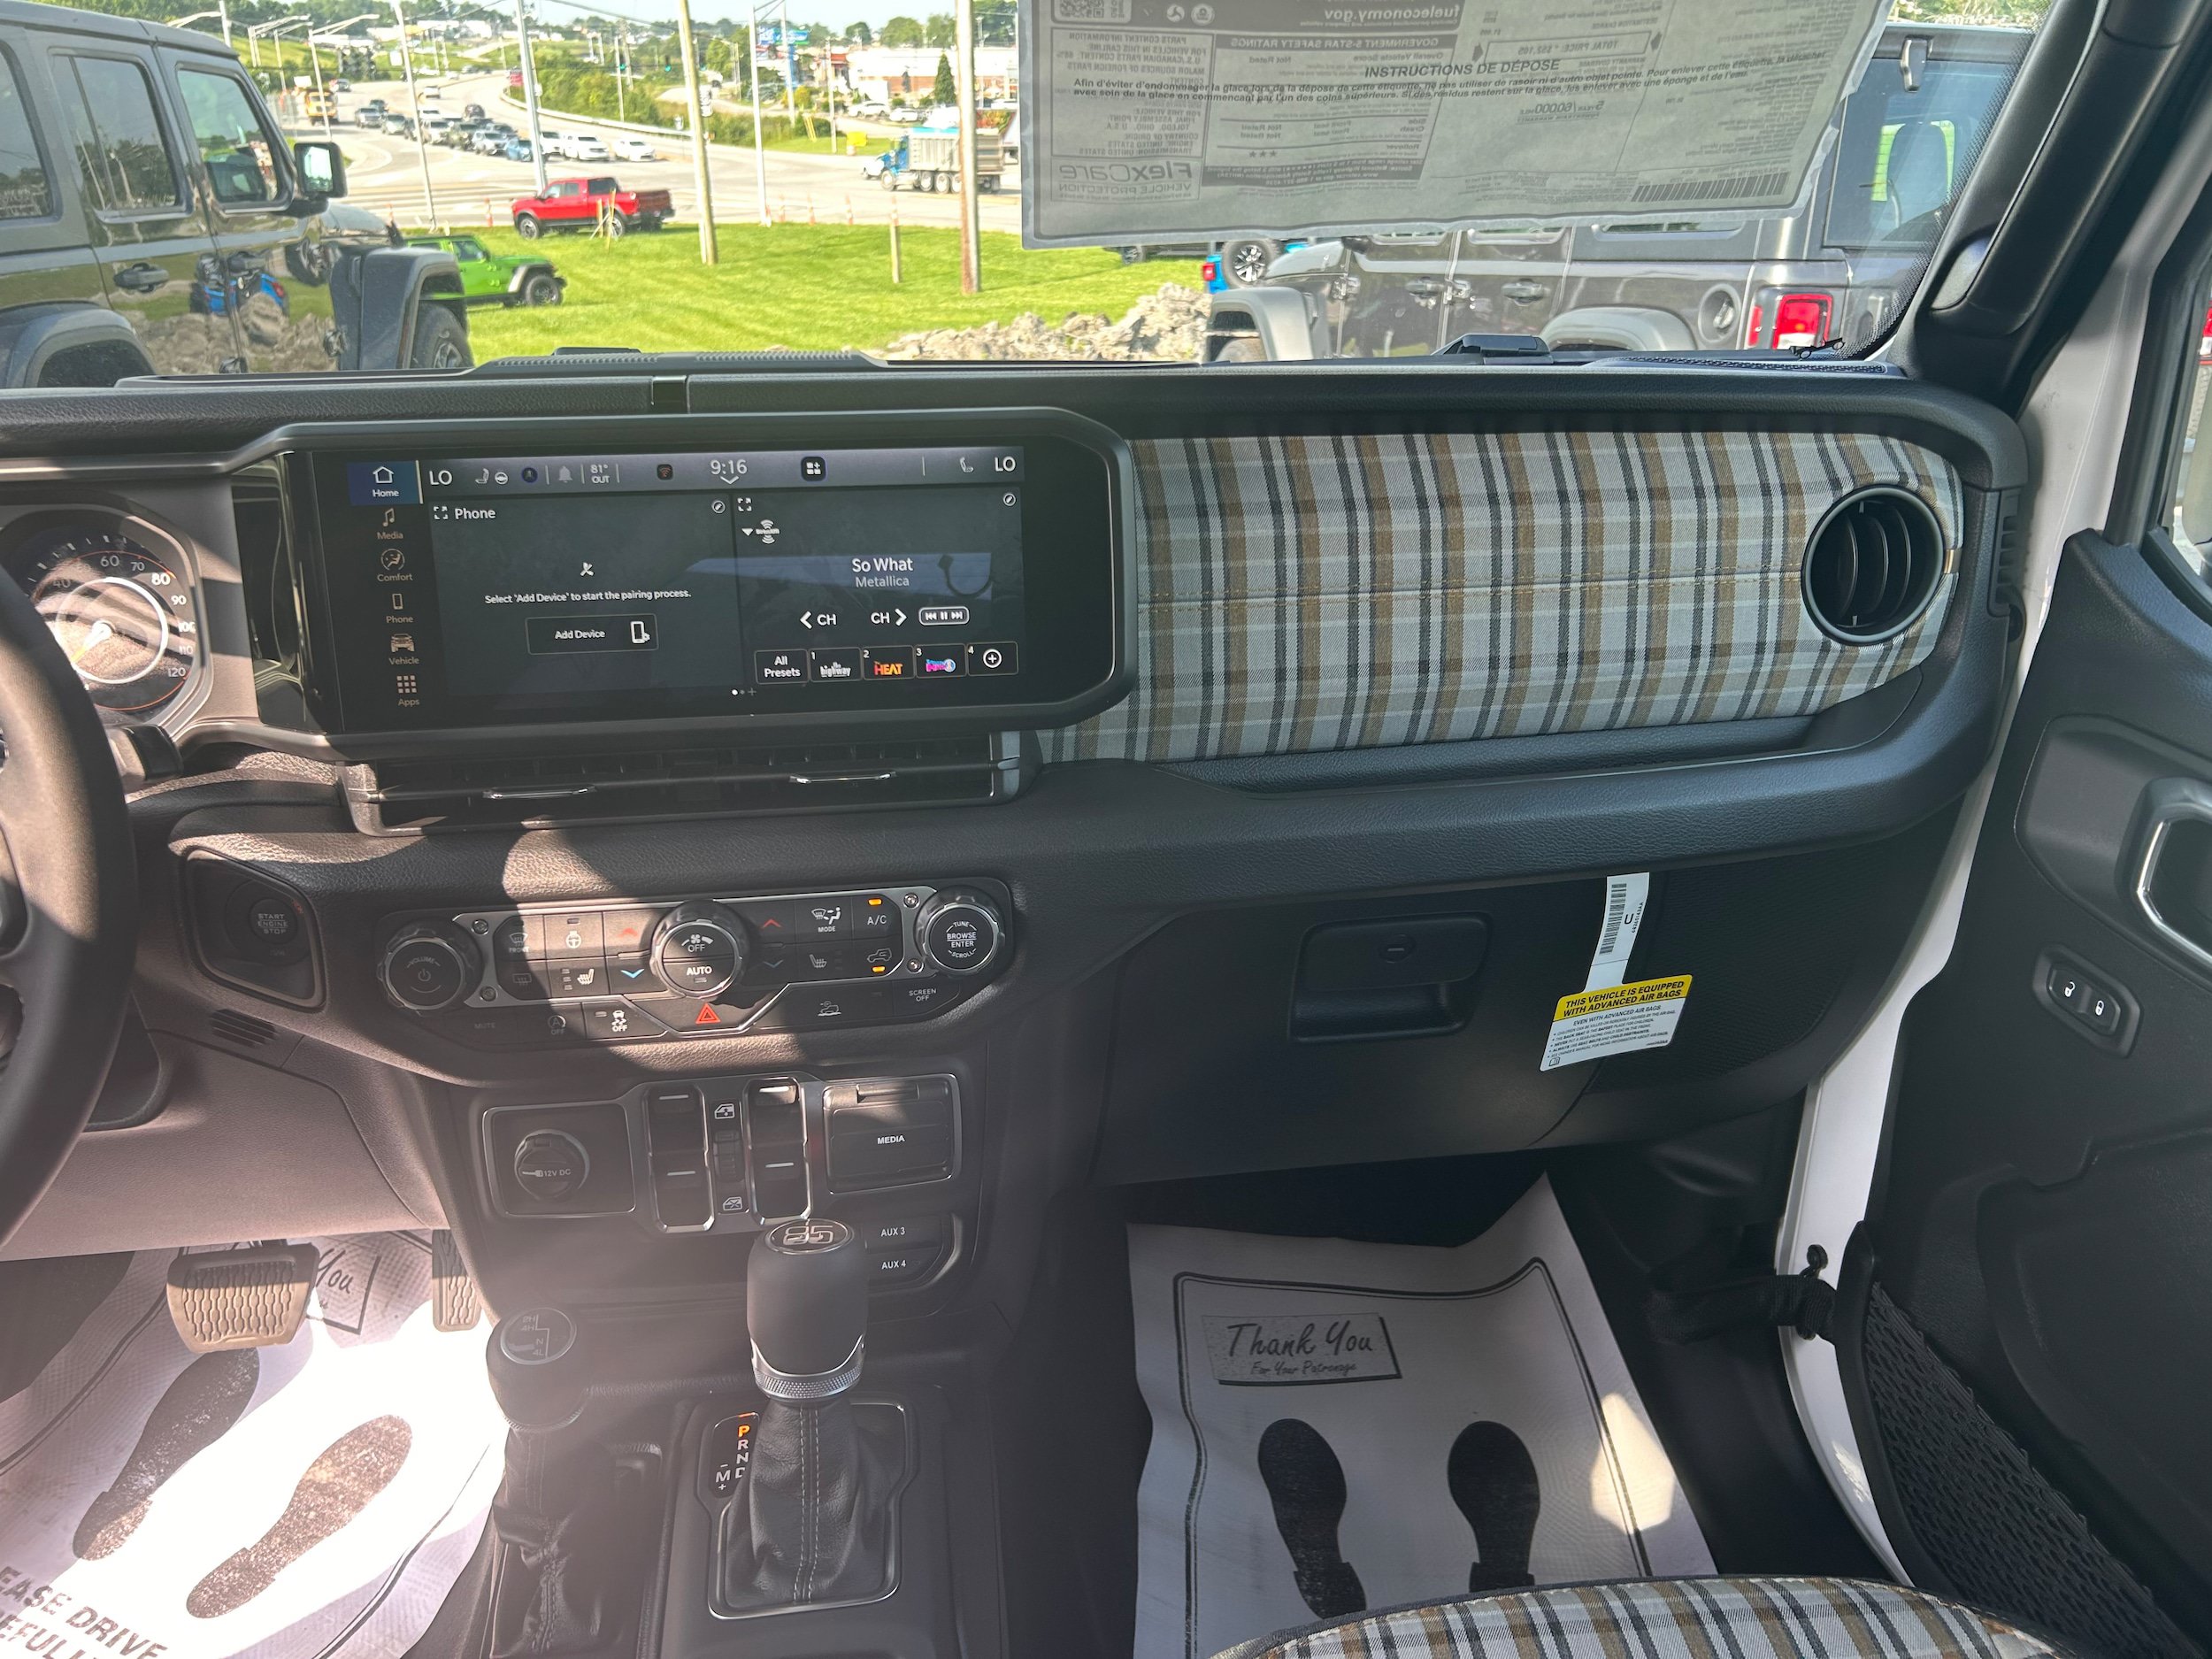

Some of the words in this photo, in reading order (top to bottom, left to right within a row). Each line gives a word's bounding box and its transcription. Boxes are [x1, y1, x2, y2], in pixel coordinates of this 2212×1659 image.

[1365, 63, 1474, 79] INSTRUCTIONS
[1477, 62, 1497, 74] DE
[1501, 58, 1560, 73] DÉPOSE
[1074, 78, 1094, 88] Afin
[1096, 79, 1133, 89] d'éviter
[1135, 80, 1210, 93] d'endommager
[1223, 84, 1249, 94] glace
[1299, 81, 1333, 93] dépose
[1440, 81, 1456, 92] pas
[1459, 79, 1493, 88] utiliser
[1494, 79, 1505, 88] de
[1509, 77, 1537, 87] rasoir
[1539, 76, 1548, 85] ni
[1550, 74, 1583, 84] d'autre
[1585, 73, 1610, 83] objet
[1647, 68, 1668, 78] Pour
[1671, 65, 1705, 75] enlever
[1708, 62, 1731, 72] cette
[1099, 88, 1119, 96] soin
[1123, 88, 1135, 97] de
[1137, 88, 1146, 98] la
[1148, 89, 1175, 100] glace
[1276, 92, 1294, 102] l'un
[1296, 91, 1314, 102] des
[1317, 91, 1342, 102] coins
[1346, 89, 1399, 101] supérieurs.
[1432, 88, 1468, 98] résidus
[1471, 87, 1504, 96] restent
[1525, 86, 1533, 96] la
[1618, 81, 1641, 89] avec
[1644, 79, 1661, 88] une
[1663, 74, 1698, 87] éponge
[1700, 73, 1709, 82] et
[1711, 72, 1722, 81] de
[590, 463, 609, 474] 81°
[710, 458, 748, 475] 9:16
[995, 456, 1016, 472] LO
[428, 470, 453, 487] LO
[591, 474, 611, 485] OUT
[373, 488, 400, 499] Home
[455, 508, 496, 520] Phone
[376, 531, 404, 541] Media
[100, 555, 121, 567] 60
[130, 561, 146, 572] 70
[852, 557, 872, 573] So
[873, 557, 914, 572] What
[150, 572, 171, 586] 80
[377, 573, 414, 583] Comfort
[855, 575, 910, 588] Metallica
[171, 594, 188, 605] 90
[485, 595, 513, 604] Select
[514, 594, 535, 603] 'Add
[535, 592, 569, 603] Device'
[571, 593, 581, 603] to
[583, 593, 603, 602] start
[604, 591, 620, 601] the
[621, 590, 653, 602] pairing
[653, 590, 692, 601] process.
[386, 615, 414, 625] Phone
[817, 613, 837, 626] CH
[870, 612, 889, 625] CH
[178, 620, 196, 634] 100
[555, 630, 574, 640] Add
[574, 629, 606, 639] Device
[179, 645, 194, 657] 110
[810, 650, 816, 661] 1
[863, 649, 870, 659] 2
[916, 648, 923, 657] 3
[967, 646, 975, 655] 4
[388, 656, 420, 666] Vehicle
[773, 656, 788, 666] All
[167, 667, 188, 678] 120
[764, 667, 801, 679] Presets
[873, 664, 903, 676] HEAT
[397, 697, 421, 708] Apps
[867, 914, 887, 926] A/C
[1624, 913, 1634, 925] U
[947, 931, 978, 941] BROWSE
[687, 943, 706, 954] OFF
[951, 940, 975, 949] ENTER
[951, 950, 975, 959] SCROLL
[685, 964, 713, 976] AUTO
[909, 987, 937, 997] SCREEN
[916, 994, 931, 1002] OFF
[1565, 997, 1586, 1009] THIS
[1588, 990, 1625, 1003] VEHICLE
[1639, 981, 1685, 994] EQUIPPED
[1563, 1005, 1586, 1018] WITH
[1587, 996, 1638, 1012] ADVANCED
[1639, 992, 1655, 1003] AIR
[1656, 988, 1682, 1000] BAGS
[1602, 1010, 1633, 1021] ADVANCED
[550, 1027, 565, 1036] OFF
[611, 1025, 627, 1033] OFF
[877, 1134, 905, 1145] MEDIA
[543, 1169, 557, 1178] 12V
[880, 1227, 899, 1237] AUX
[899, 1226, 906, 1235] 3
[880, 1260, 900, 1271] AUX
[900, 1259, 907, 1269] 4
[1226, 1322, 1317, 1357] Thank
[1325, 1319, 1374, 1356] You
[1251, 1361, 1271, 1375] For
[1274, 1361, 1300, 1376] Your
[1302, 1360, 1357, 1377] Patronage
[738, 1425, 750, 1438] P
[737, 1439, 749, 1451] R
[736, 1452, 749, 1464] N
[715, 1469, 732, 1483] M
